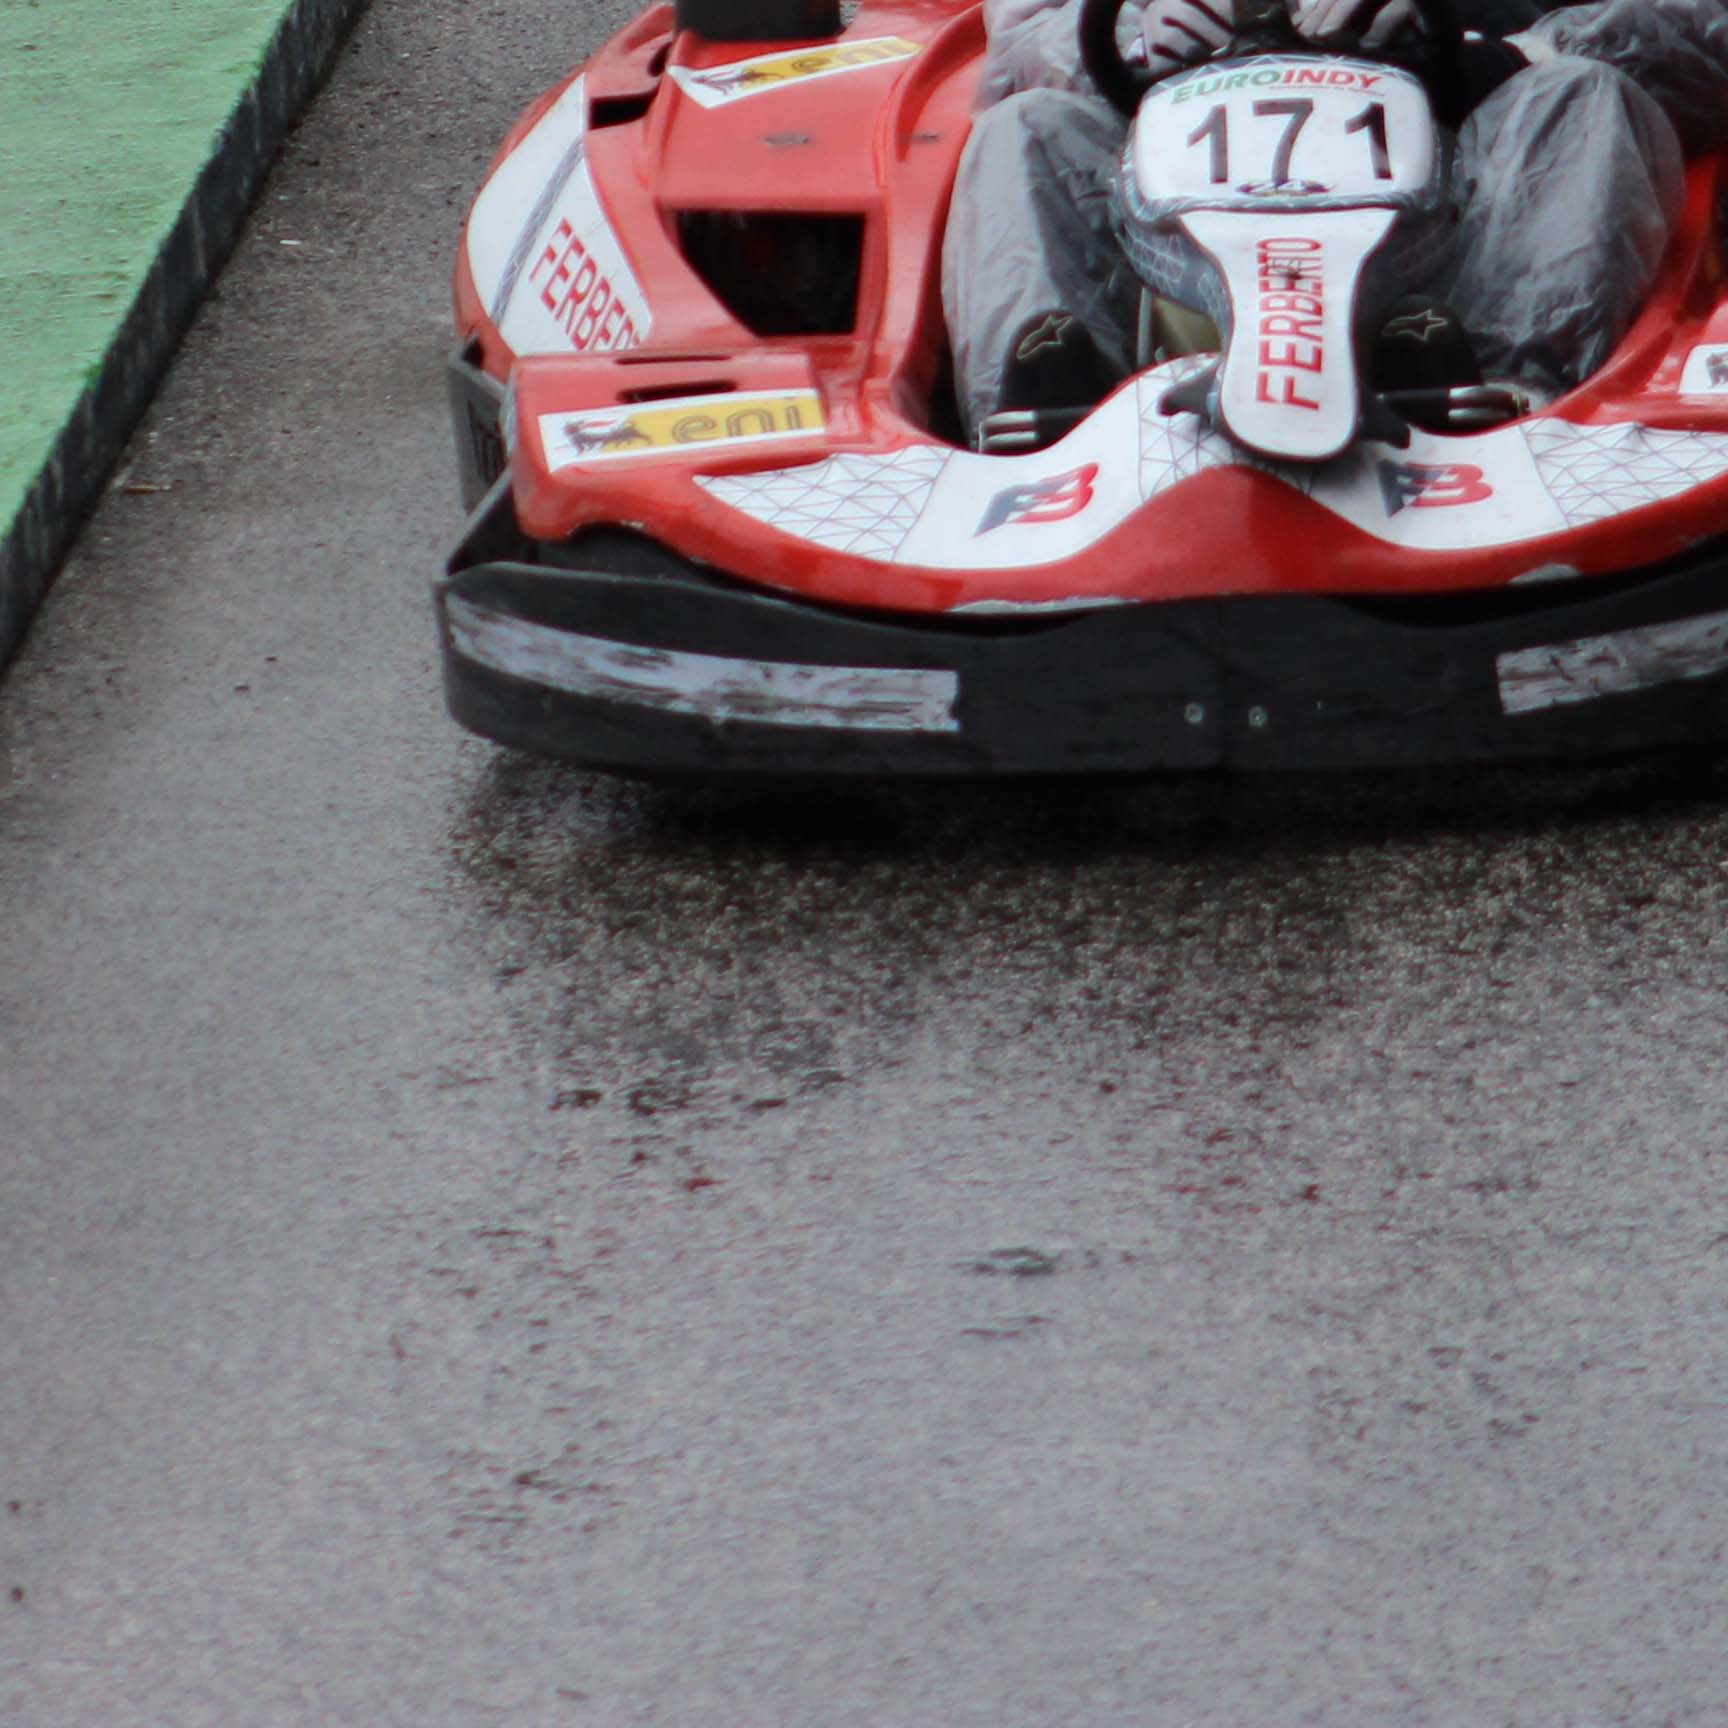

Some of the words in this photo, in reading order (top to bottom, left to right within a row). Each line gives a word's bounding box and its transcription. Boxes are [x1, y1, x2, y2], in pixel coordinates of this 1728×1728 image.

[1171, 68, 1383, 105] EUROINDY
[1186, 97, 1393, 185] 171
[1255, 236, 1324, 411] FERBERTO
[672, 396, 803, 443] eni
